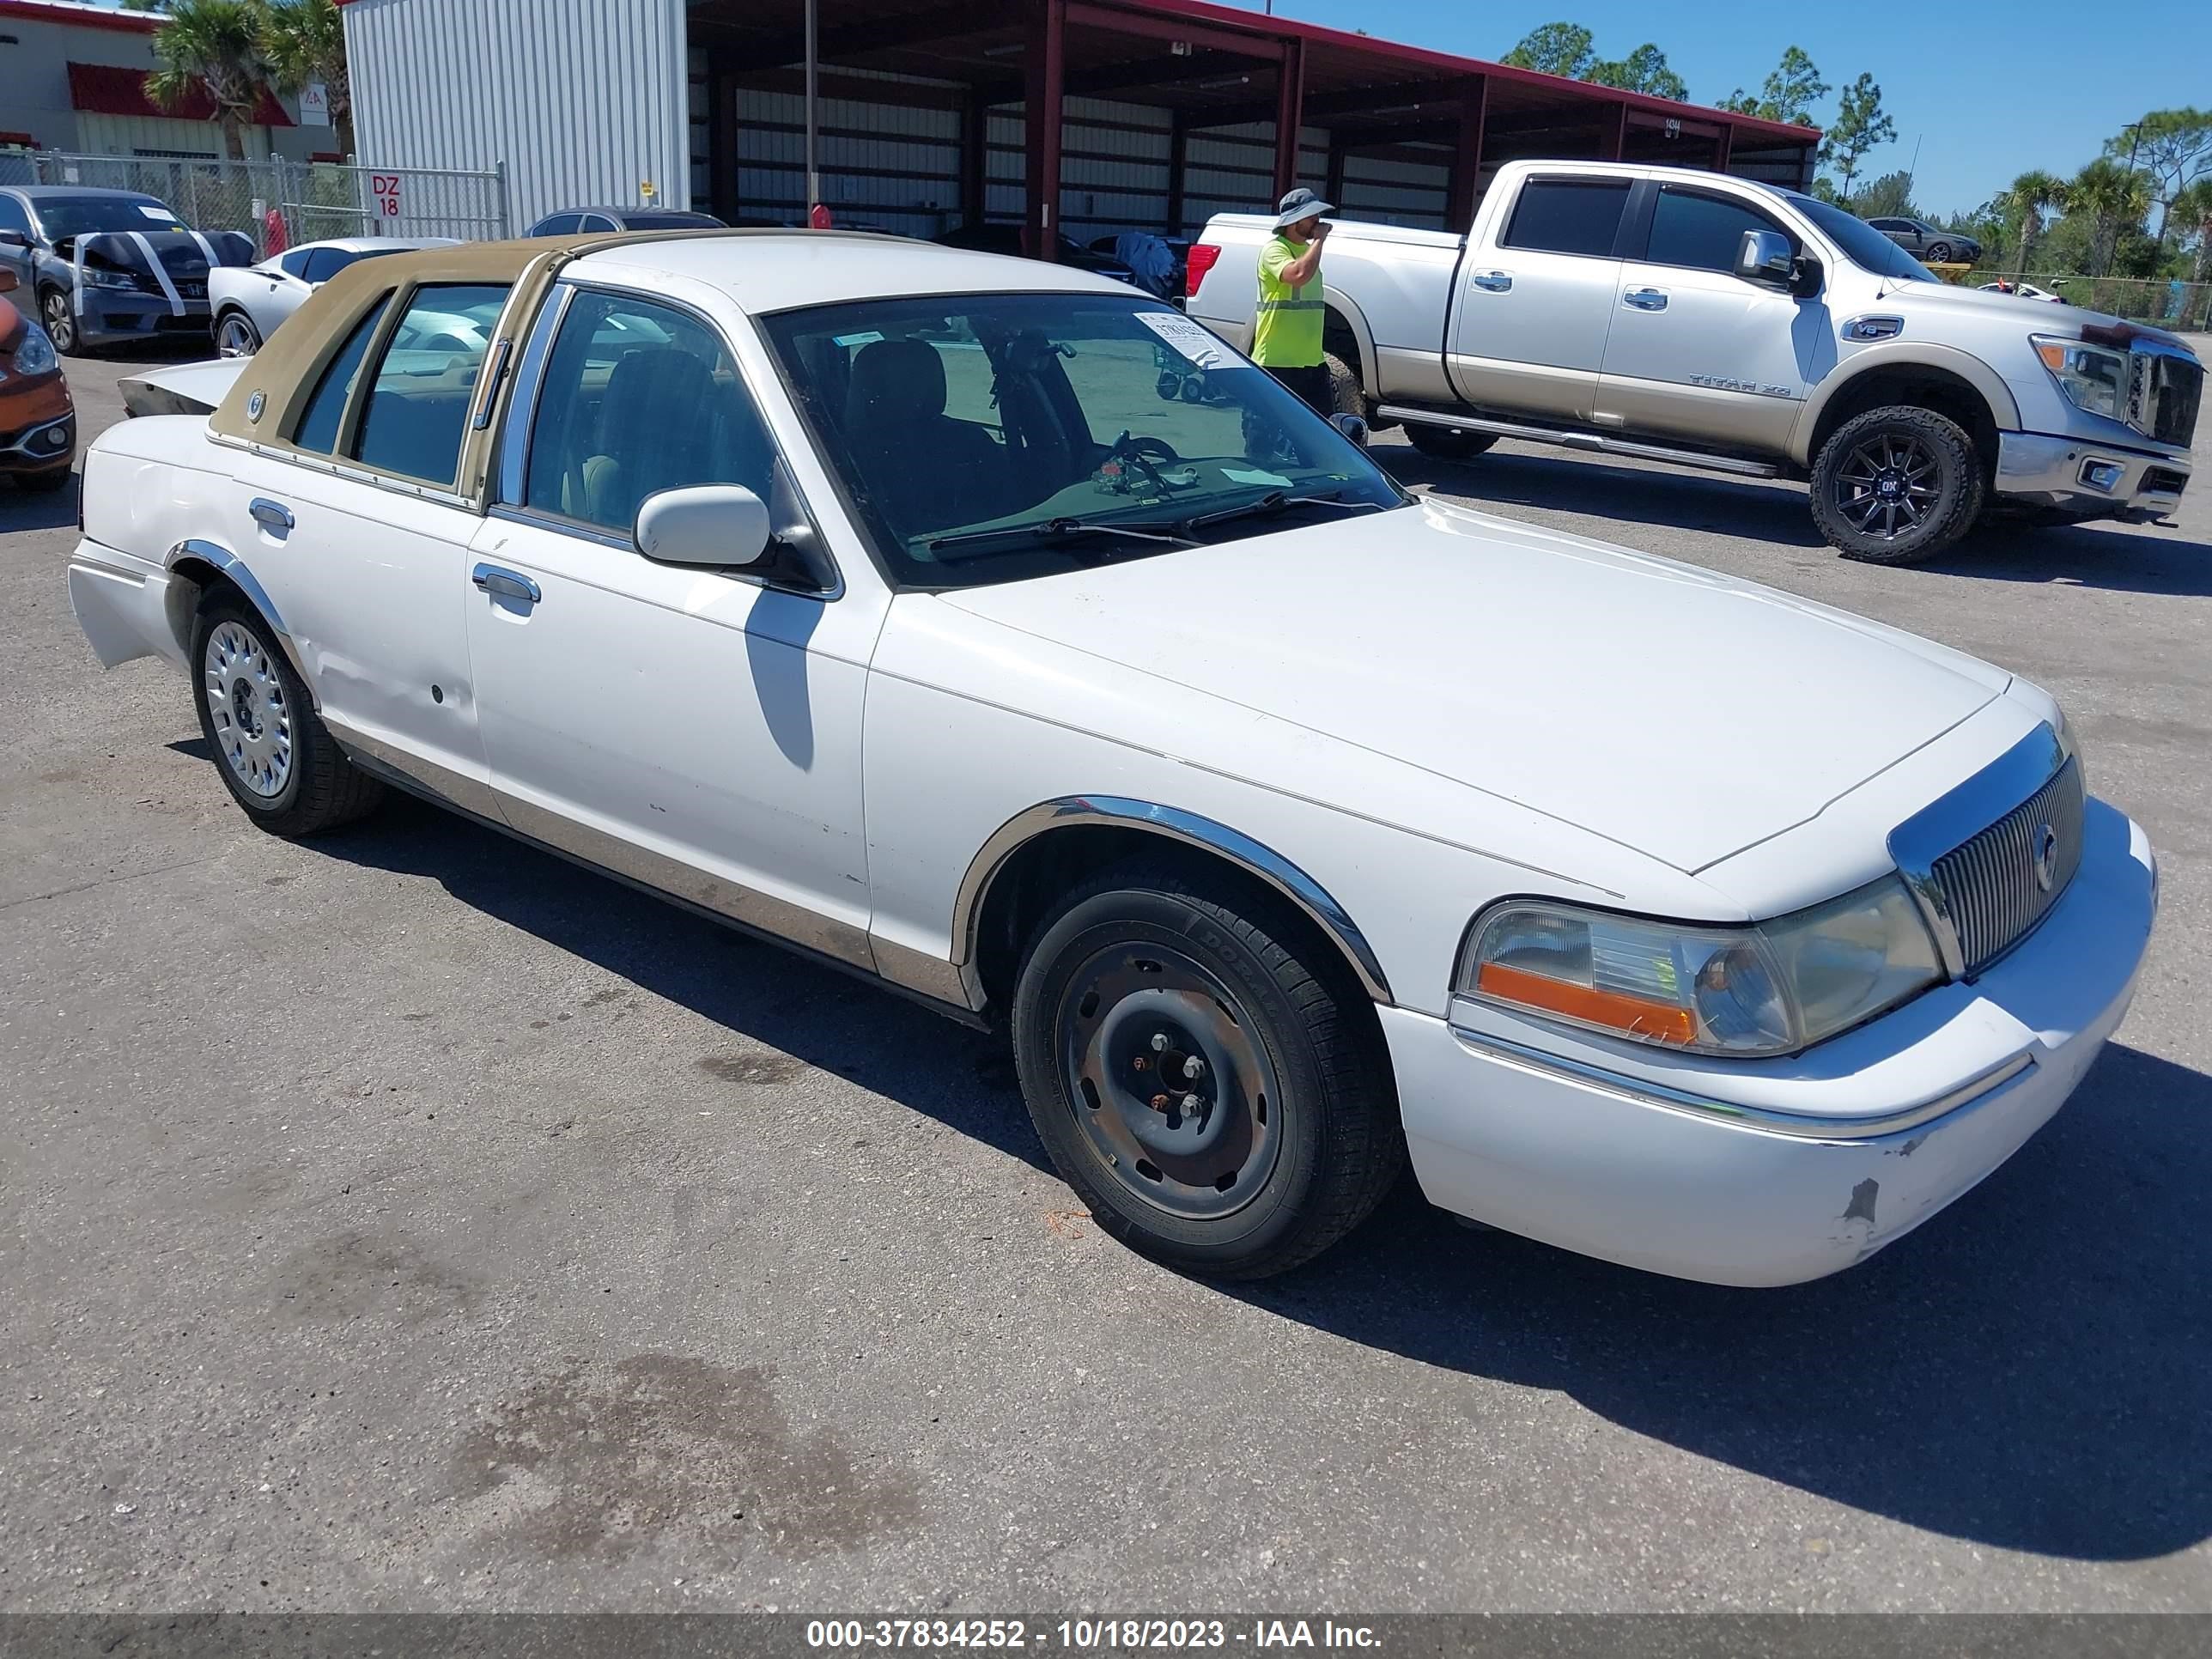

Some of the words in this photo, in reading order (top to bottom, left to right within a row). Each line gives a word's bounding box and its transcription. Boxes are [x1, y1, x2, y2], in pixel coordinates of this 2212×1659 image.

[373, 175, 400, 196] DZ
[380, 198, 398, 216] 18
[1857, 324, 1877, 334] V8
[1689, 372, 1757, 392] TITAN
